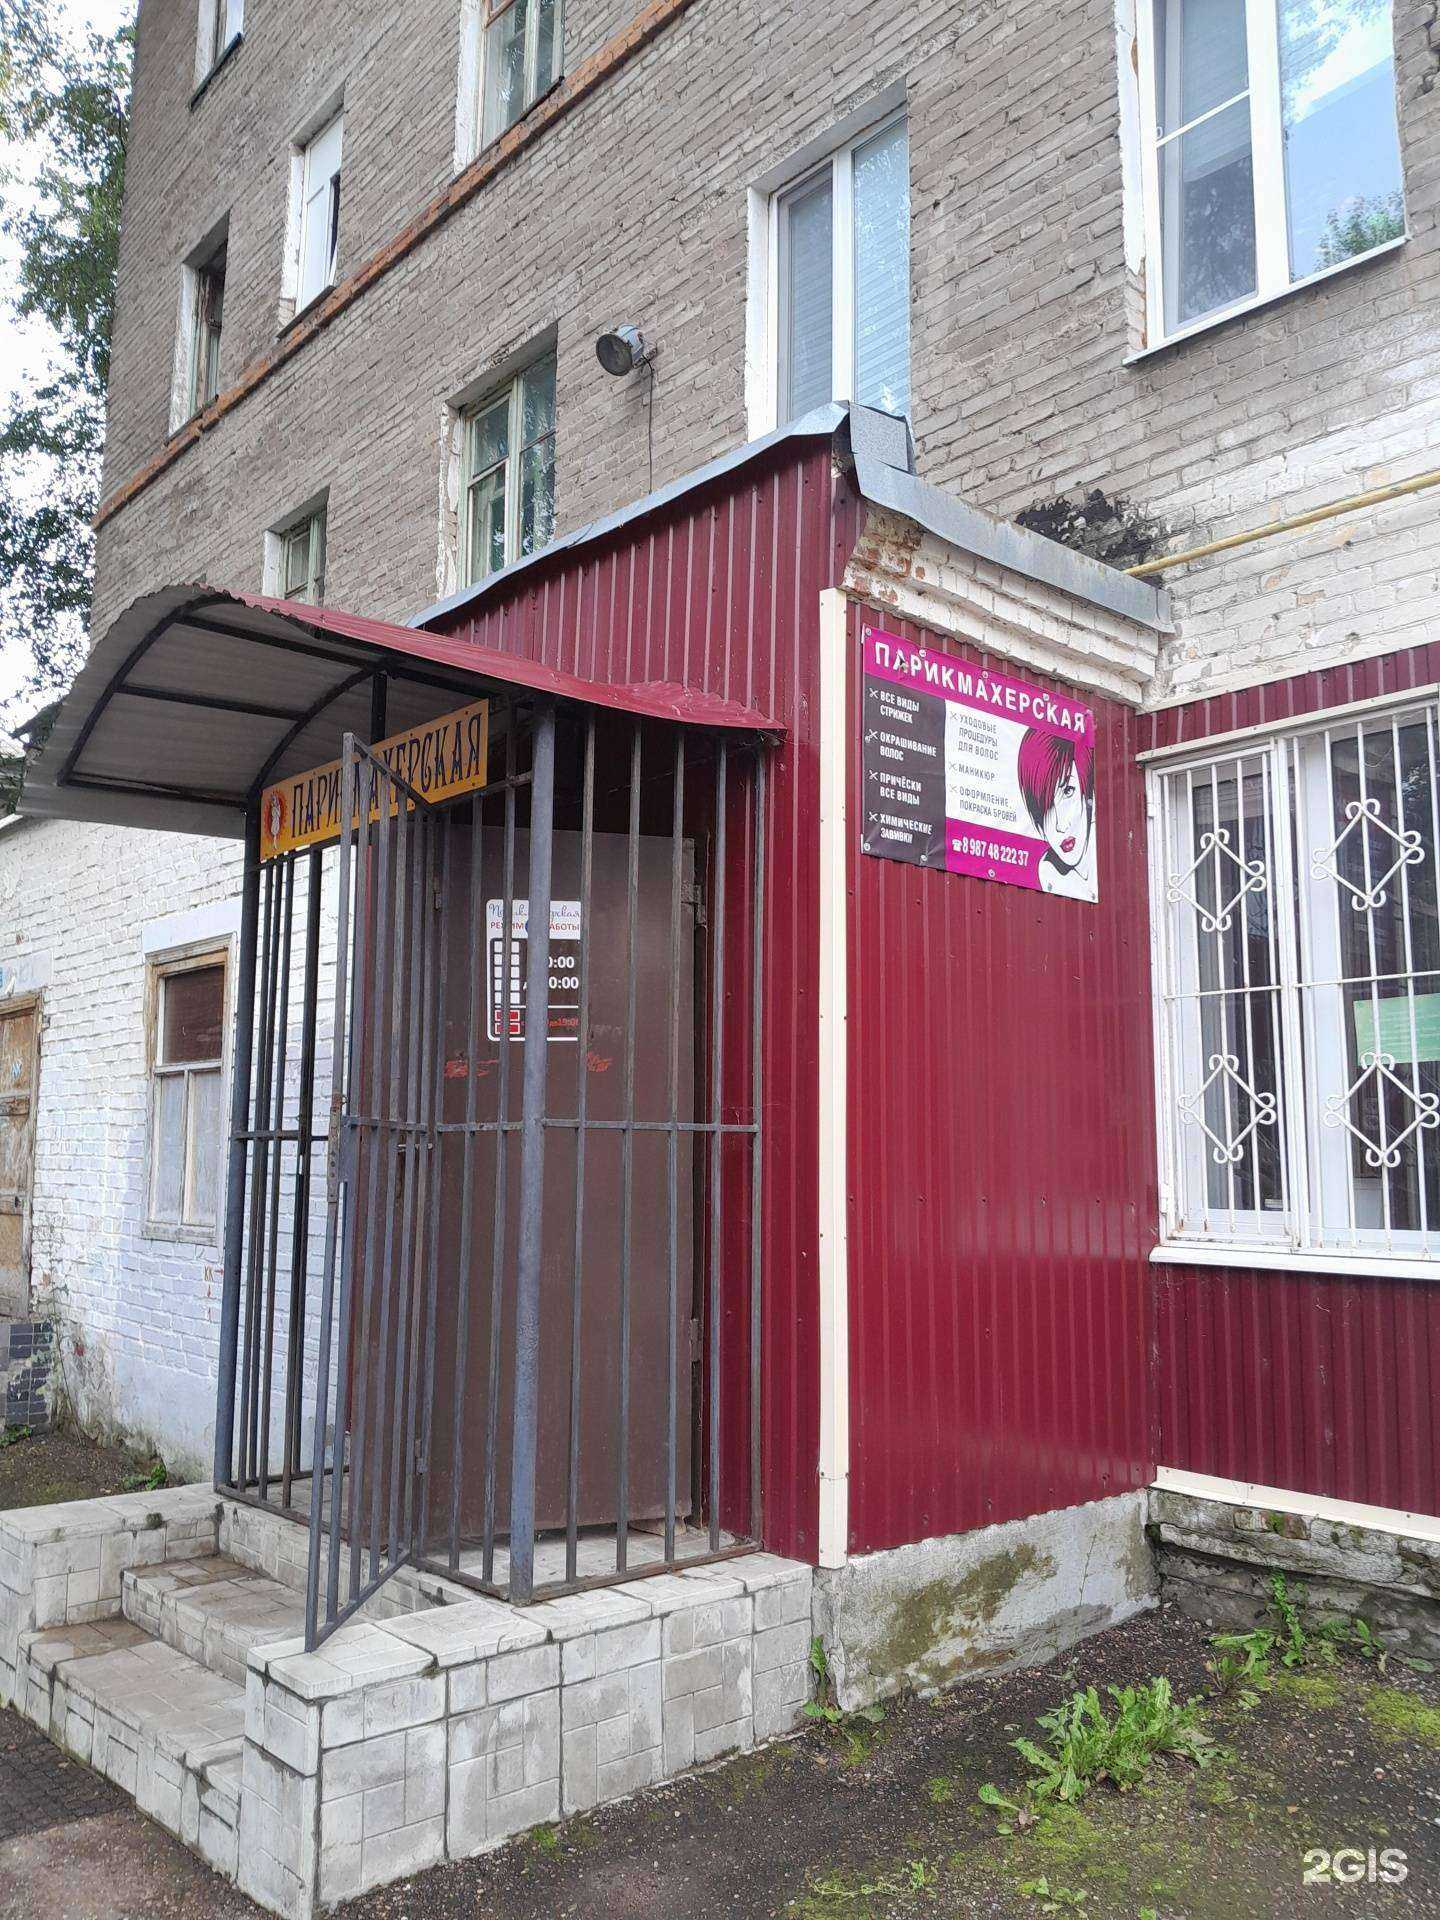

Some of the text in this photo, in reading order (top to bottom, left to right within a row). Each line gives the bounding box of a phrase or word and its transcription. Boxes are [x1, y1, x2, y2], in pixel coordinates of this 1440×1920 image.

[874, 641, 1085, 734] ПАРИКМАХЕРСКАЯ
[880, 690, 919, 712] ВСЕ ВИДЫ
[880, 705, 913, 723] СТРИЖЕК
[959, 714, 997, 734] УХОДОВЫЕ
[880, 732, 937, 757] ОКРАШИВАНИЕ
[959, 727, 998, 747] ПРОЦЕДУРЫ
[880, 745, 904, 761] ВОЛОС
[958, 741, 999, 761] ДЛЯ ВОЛОС
[291, 713, 482, 838] ПАРИАХЕРСКАЯ
[958, 763, 996, 781] МАНИКЮР
[880, 786, 920, 806] ВСЕ ВИДЫ
[959, 800, 1017, 822] ПОКРАСКА БРОВЕЙ
[880, 813, 933, 835] ХИМИЧЕСКИЕ
[880, 828, 913, 844] ЗАВИВКИ
[490, 921, 580, 931] РЕМ АБОТЫ
